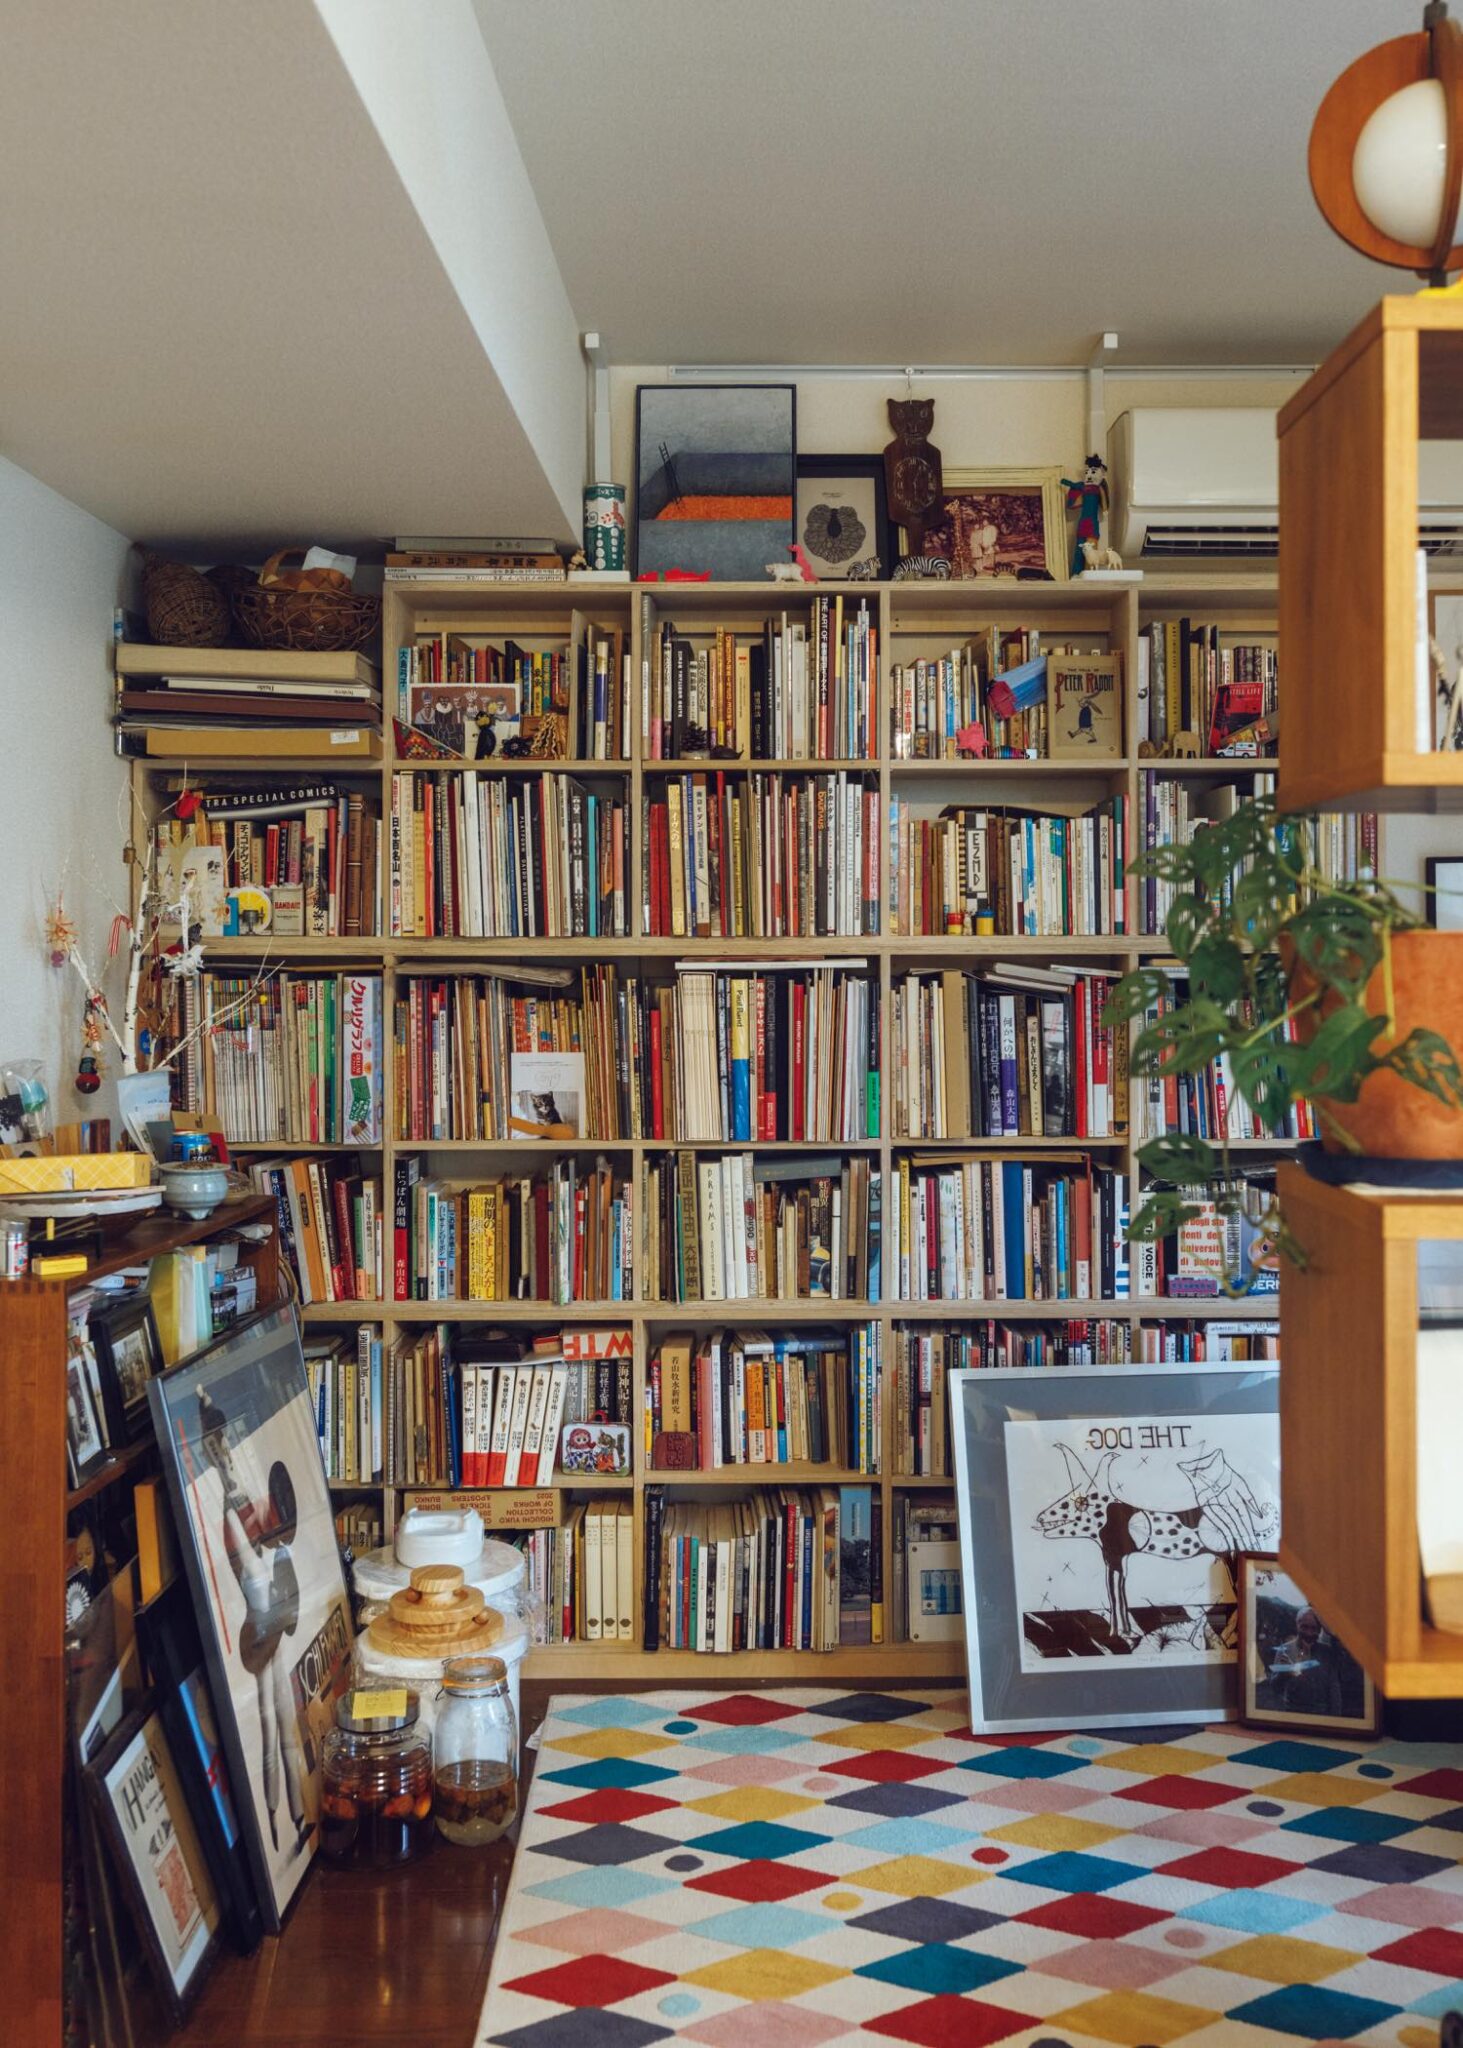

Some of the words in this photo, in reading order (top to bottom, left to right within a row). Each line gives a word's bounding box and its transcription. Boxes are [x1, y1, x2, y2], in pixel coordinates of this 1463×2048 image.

[233, 792, 286, 805] SPECIAL
[290, 786, 336, 799] COMICS
[817, 791, 827, 830] bauhaus
[392, 817, 401, 872] 日本百名山
[707, 1168, 717, 1232] DREAMS
[1145, 1247, 1154, 1280] VOICE
[671, 1356, 680, 1415] 若山牧水新研究
[499, 1515, 520, 1524] YUKO
[506, 1507, 554, 1516] COLLECTION
[513, 1500, 541, 1508] WORKS
